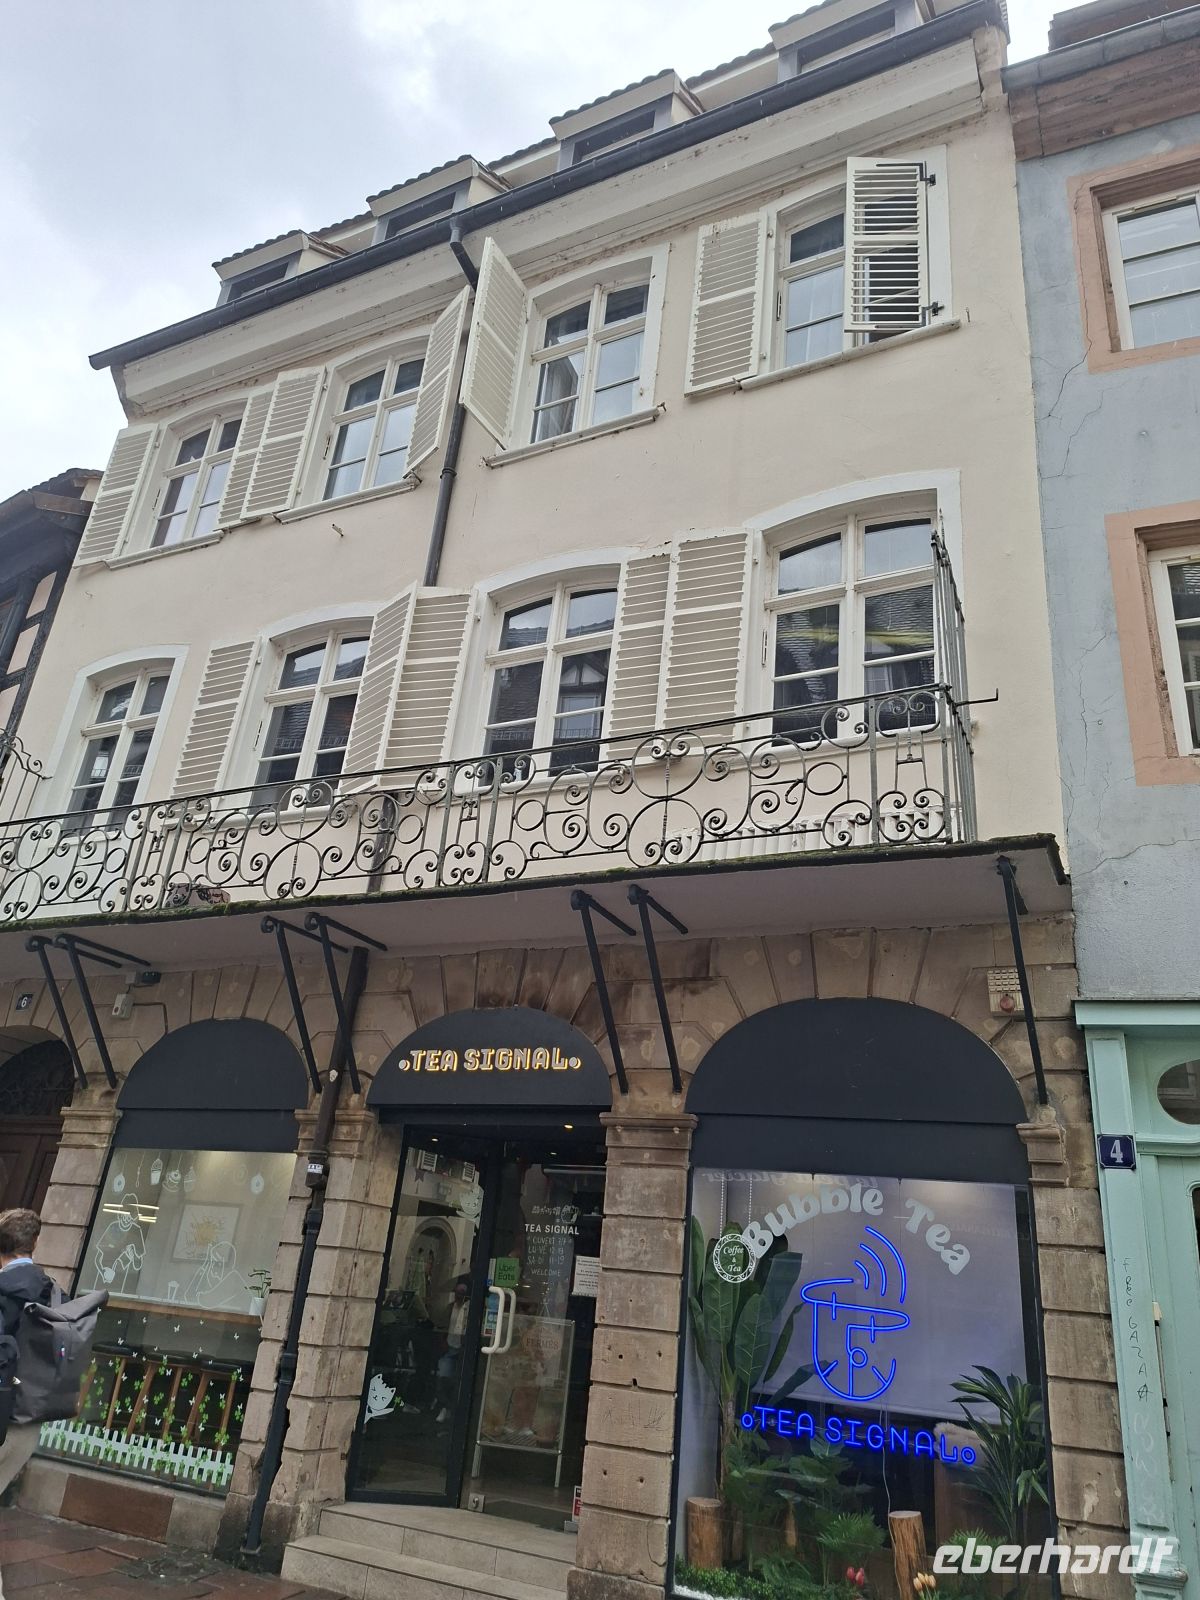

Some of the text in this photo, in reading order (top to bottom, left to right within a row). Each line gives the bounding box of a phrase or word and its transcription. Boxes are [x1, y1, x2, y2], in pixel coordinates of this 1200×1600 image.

[21, 996, 28, 1008] 6
[409, 1047, 569, 1072] TEA SIGNAL
[1110, 1139, 1124, 1163] 4
[524, 1223, 580, 1235] TEA SIGNAL
[741, 1183, 971, 1275] Bubble Tea
[723, 1245, 745, 1256] Coffee
[530, 1268, 561, 1277] WELCOME
[727, 1264, 742, 1272] Tea
[753, 1405, 959, 1463] TEA SIGNAL
